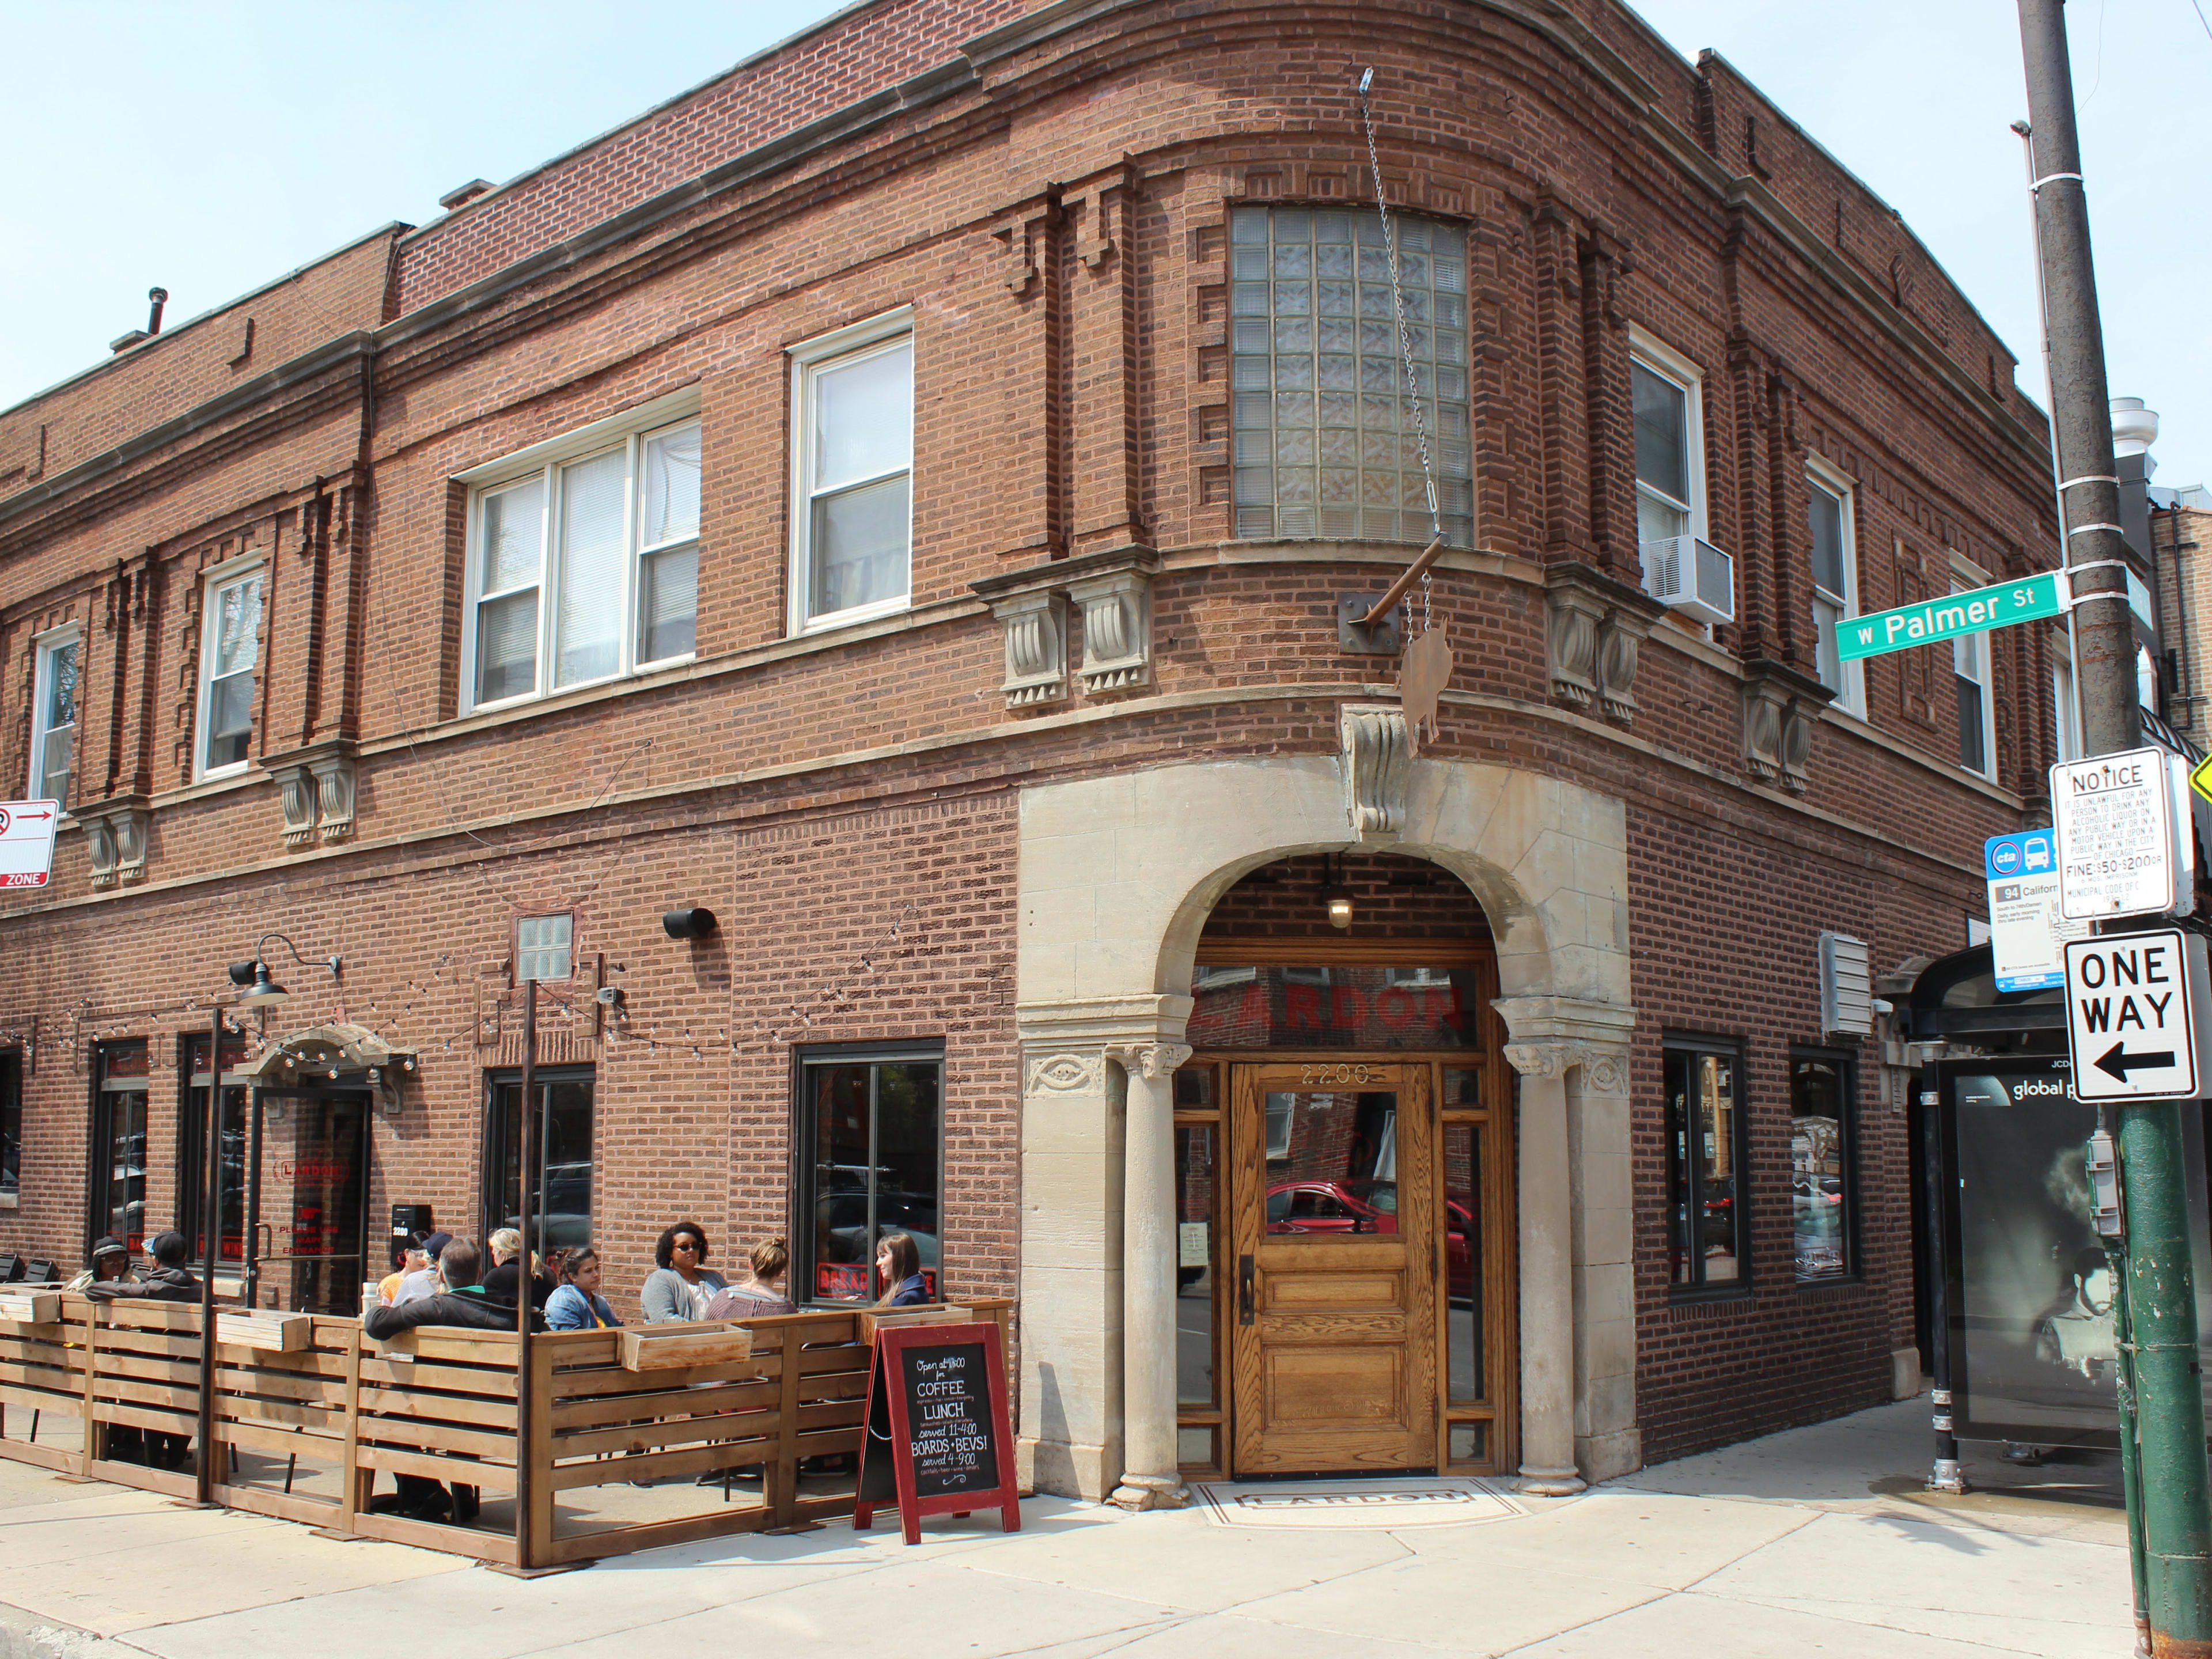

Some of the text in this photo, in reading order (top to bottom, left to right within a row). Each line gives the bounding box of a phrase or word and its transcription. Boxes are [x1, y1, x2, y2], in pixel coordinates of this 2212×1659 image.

[1857, 587, 2035, 645] W Palmer St
[2073, 765, 2143, 793] NOTICE
[2065, 788, 2153, 809] IT IS UNLAWFUL FOR ANY
[2071, 798, 2150, 817] PERSON TO DRINK ANY
[2069, 816, 2156, 836] ANY PUBLIC WAY OR IN A
[2072, 807, 2150, 827] ALCOHOLIC LIQUOR ON
[2070, 835, 2154, 854] PUBLIC WAY IN THE CITY
[2071, 835, 2094, 845] MOTOR
[2097, 830, 2124, 841] VEHICLE
[2127, 827, 2145, 838] UPON
[1997, 851, 2017, 863] cta
[2093, 848, 2134, 861] OF CHICAGO
[6, 873, 40, 885] ZONE
[2005, 887, 2018, 899] 94
[2067, 886, 2103, 899] MUNICIPAL
[2105, 883, 2123, 894] CODE
[2124, 881, 2134, 891] OF
[2081, 947, 2169, 990] ONE
[1187, 984, 1464, 1030] LARDON
[2081, 992, 2173, 1033] WAY
[1301, 1063, 1369, 1084] 2200
[2013, 1079, 2063, 1100] global
[284, 1165, 340, 1176] LARDON
[393, 1226, 408, 1236] 2200
[820, 1270, 868, 1290] BREAD
[917, 1359, 937, 1375] Open
[939, 1357, 948, 1369] at
[936, 1370, 945, 1381] for
[917, 1380, 965, 1397] COFFEE
[924, 1402, 965, 1420] LUNCH
[918, 1423, 977, 1438] served 11-4:00
[911, 1435, 987, 1457] BOARDS BEVS!
[922, 1453, 946, 1467] served
[1253, 1493, 1458, 1505] LARDON
